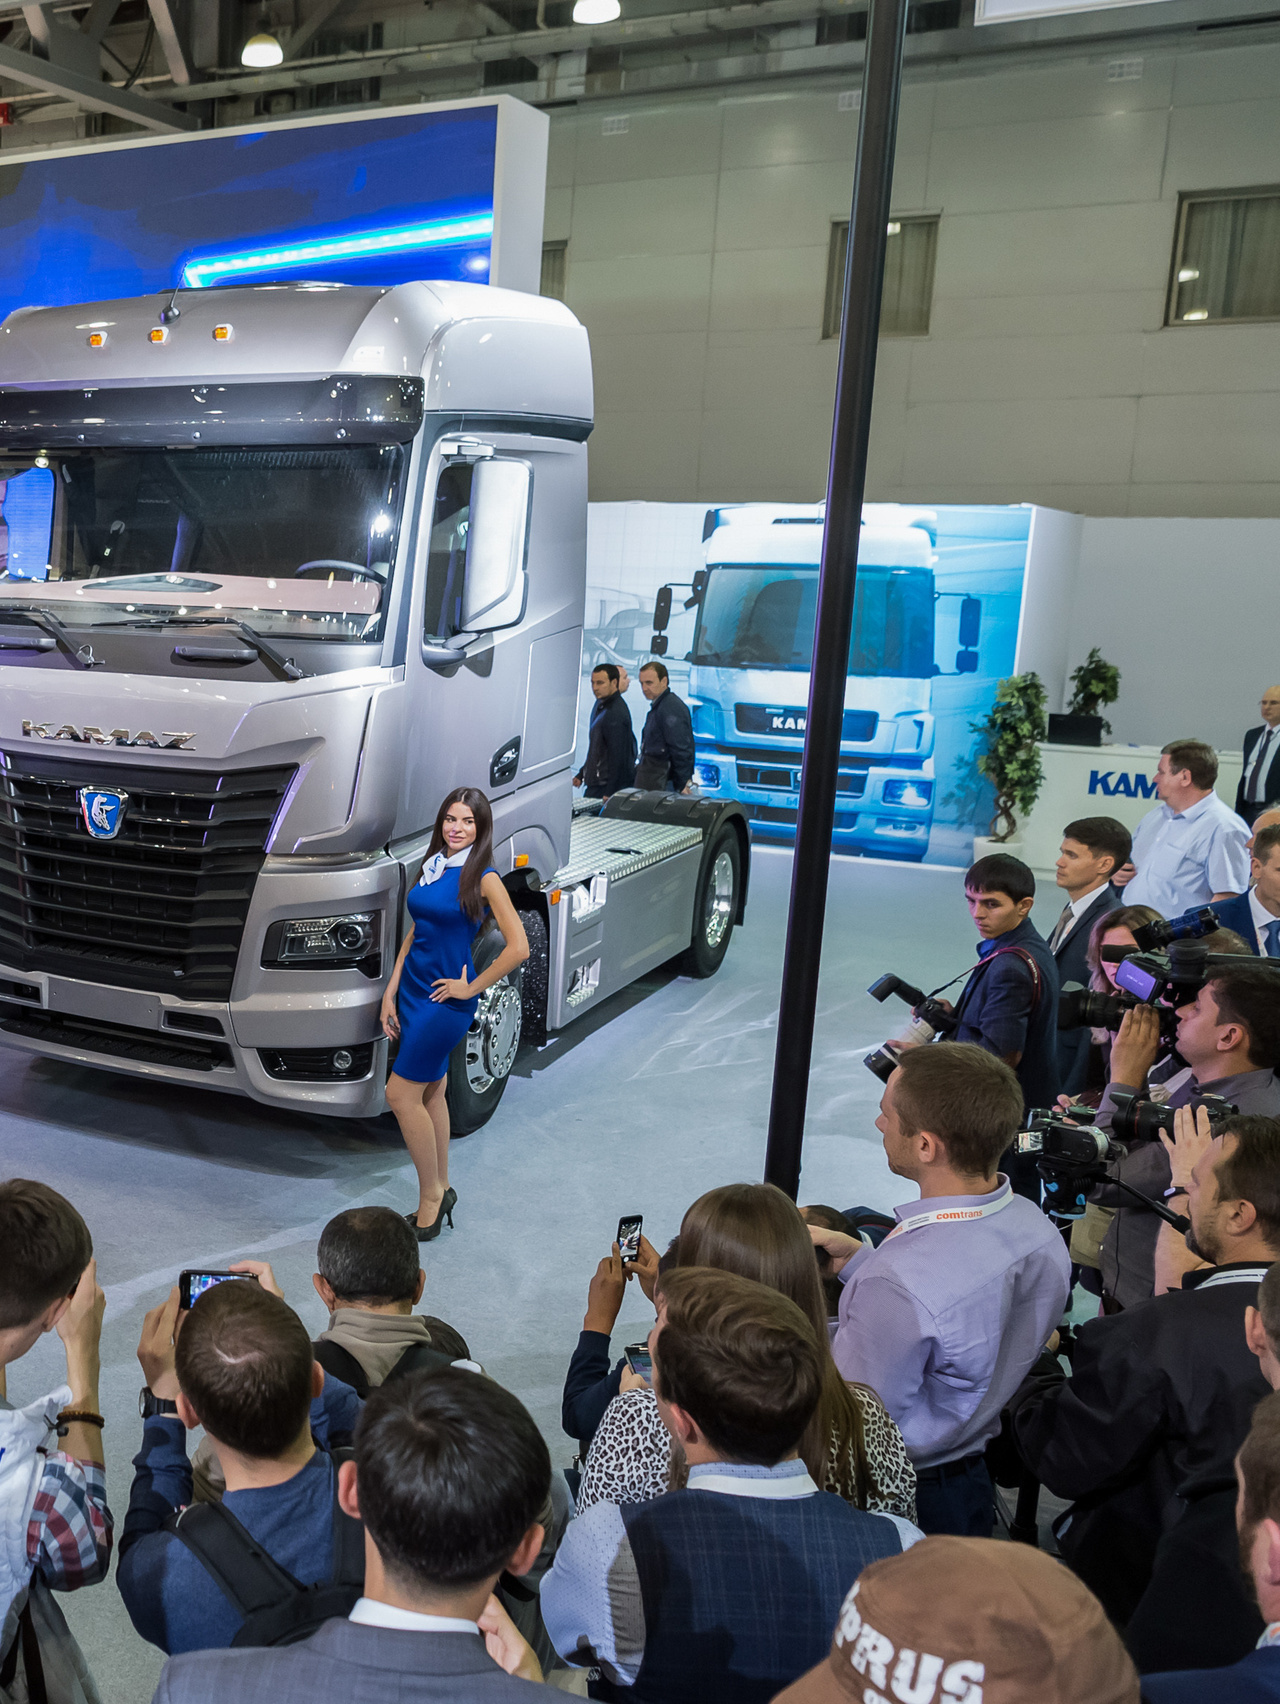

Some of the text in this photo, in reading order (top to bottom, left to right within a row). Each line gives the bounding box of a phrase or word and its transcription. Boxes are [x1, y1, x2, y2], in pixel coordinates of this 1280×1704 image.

[22, 719, 197, 751] KAMAZ
[772, 716, 807, 730] KAM
[1088, 770, 1159, 800] KAM
[936, 1210, 983, 1220] comtrans
[834, 1580, 985, 1704] PRUS
